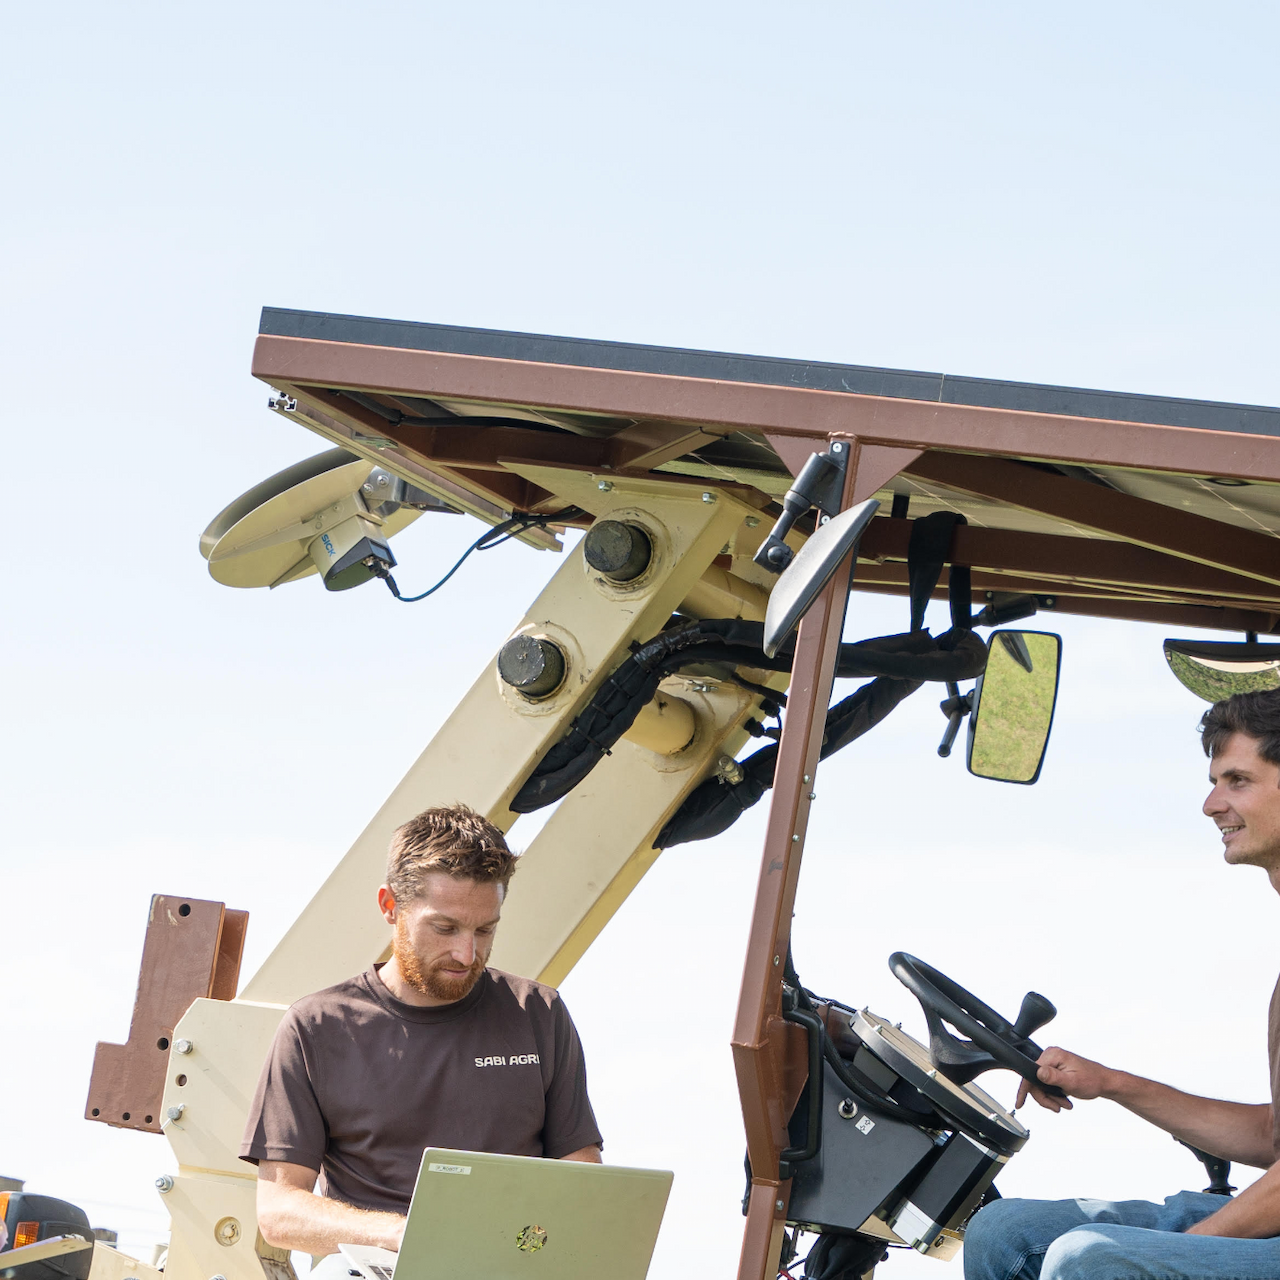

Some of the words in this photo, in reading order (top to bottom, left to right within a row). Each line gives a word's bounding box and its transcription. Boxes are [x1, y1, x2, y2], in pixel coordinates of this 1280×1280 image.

[321, 533, 336, 557] SICK
[474, 1055, 506, 1068] SABI
[509, 1053, 540, 1066] AGRI
